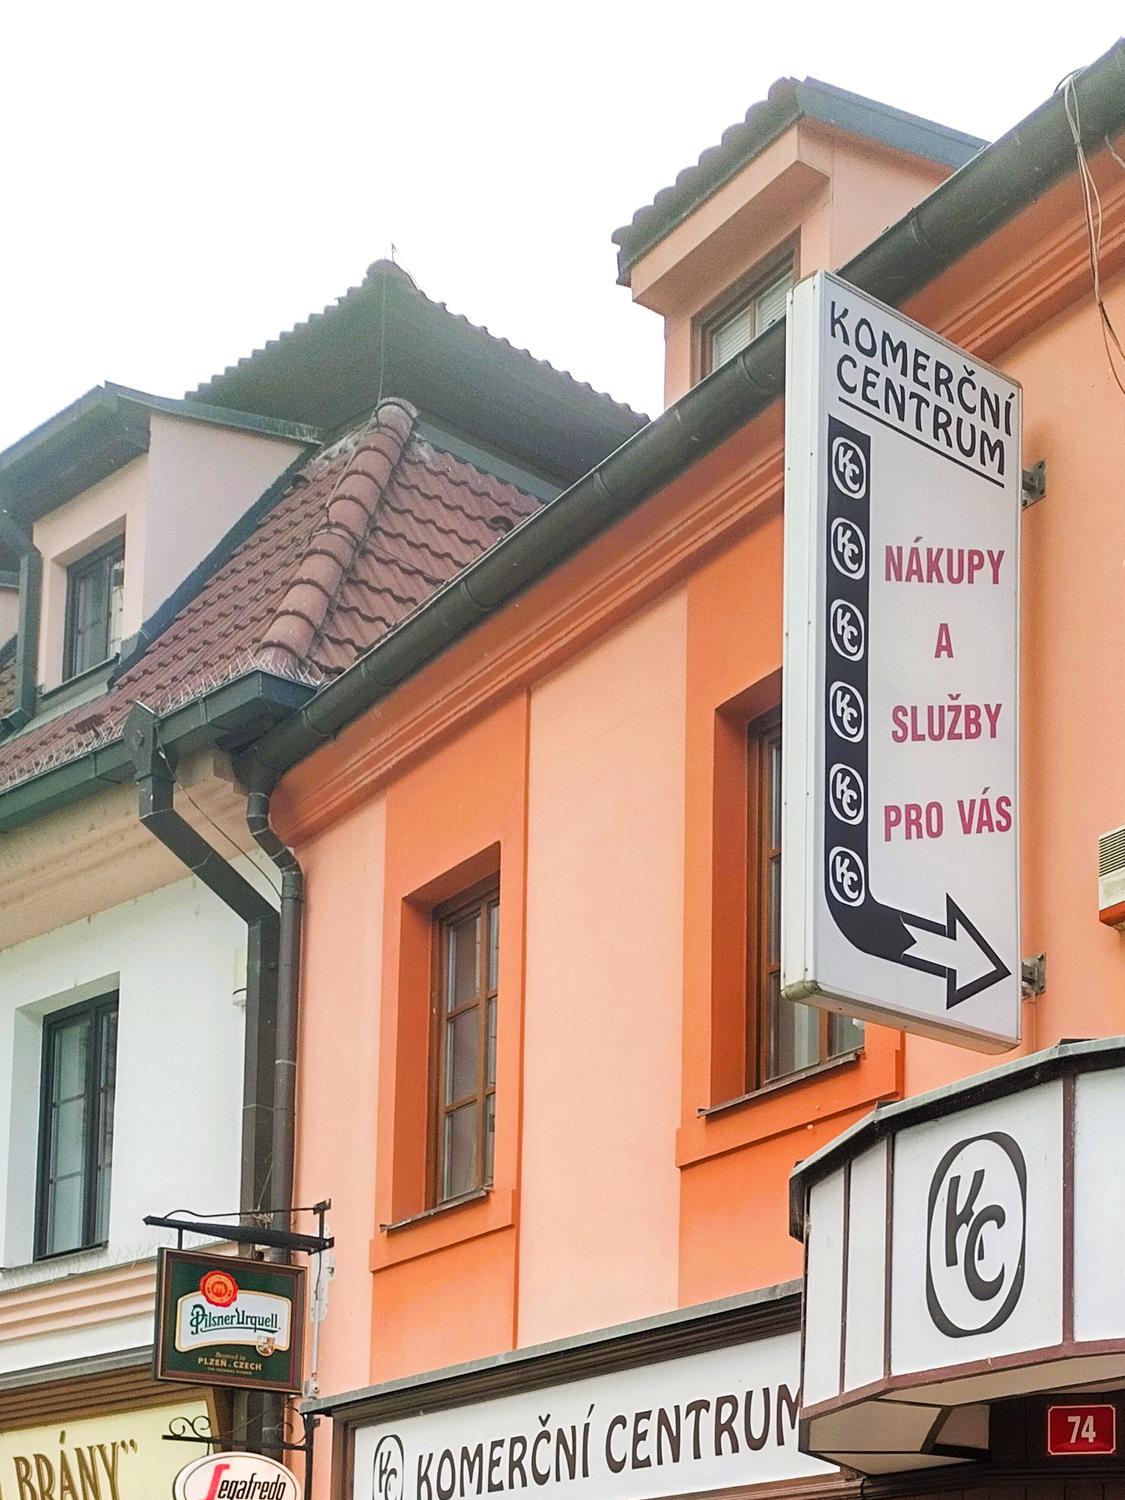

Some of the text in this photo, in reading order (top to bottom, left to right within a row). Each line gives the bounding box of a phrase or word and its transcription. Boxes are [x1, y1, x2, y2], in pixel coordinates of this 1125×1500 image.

[830, 301, 1016, 438] KOMERČNÍ
[836, 353, 1006, 476] CENTRUM
[884, 537, 1006, 586] NÁKUPY
[934, 622, 954, 660] A
[891, 694, 1003, 744] SLUŽBY
[884, 786, 1013, 843] PRO VÁS
[190, 1304, 279, 1335] Pilsner Urquell
[233, 1360, 262, 1371] CZECH
[605, 1384, 801, 1473] CENTRUM
[1067, 1415, 1097, 1444] 74
